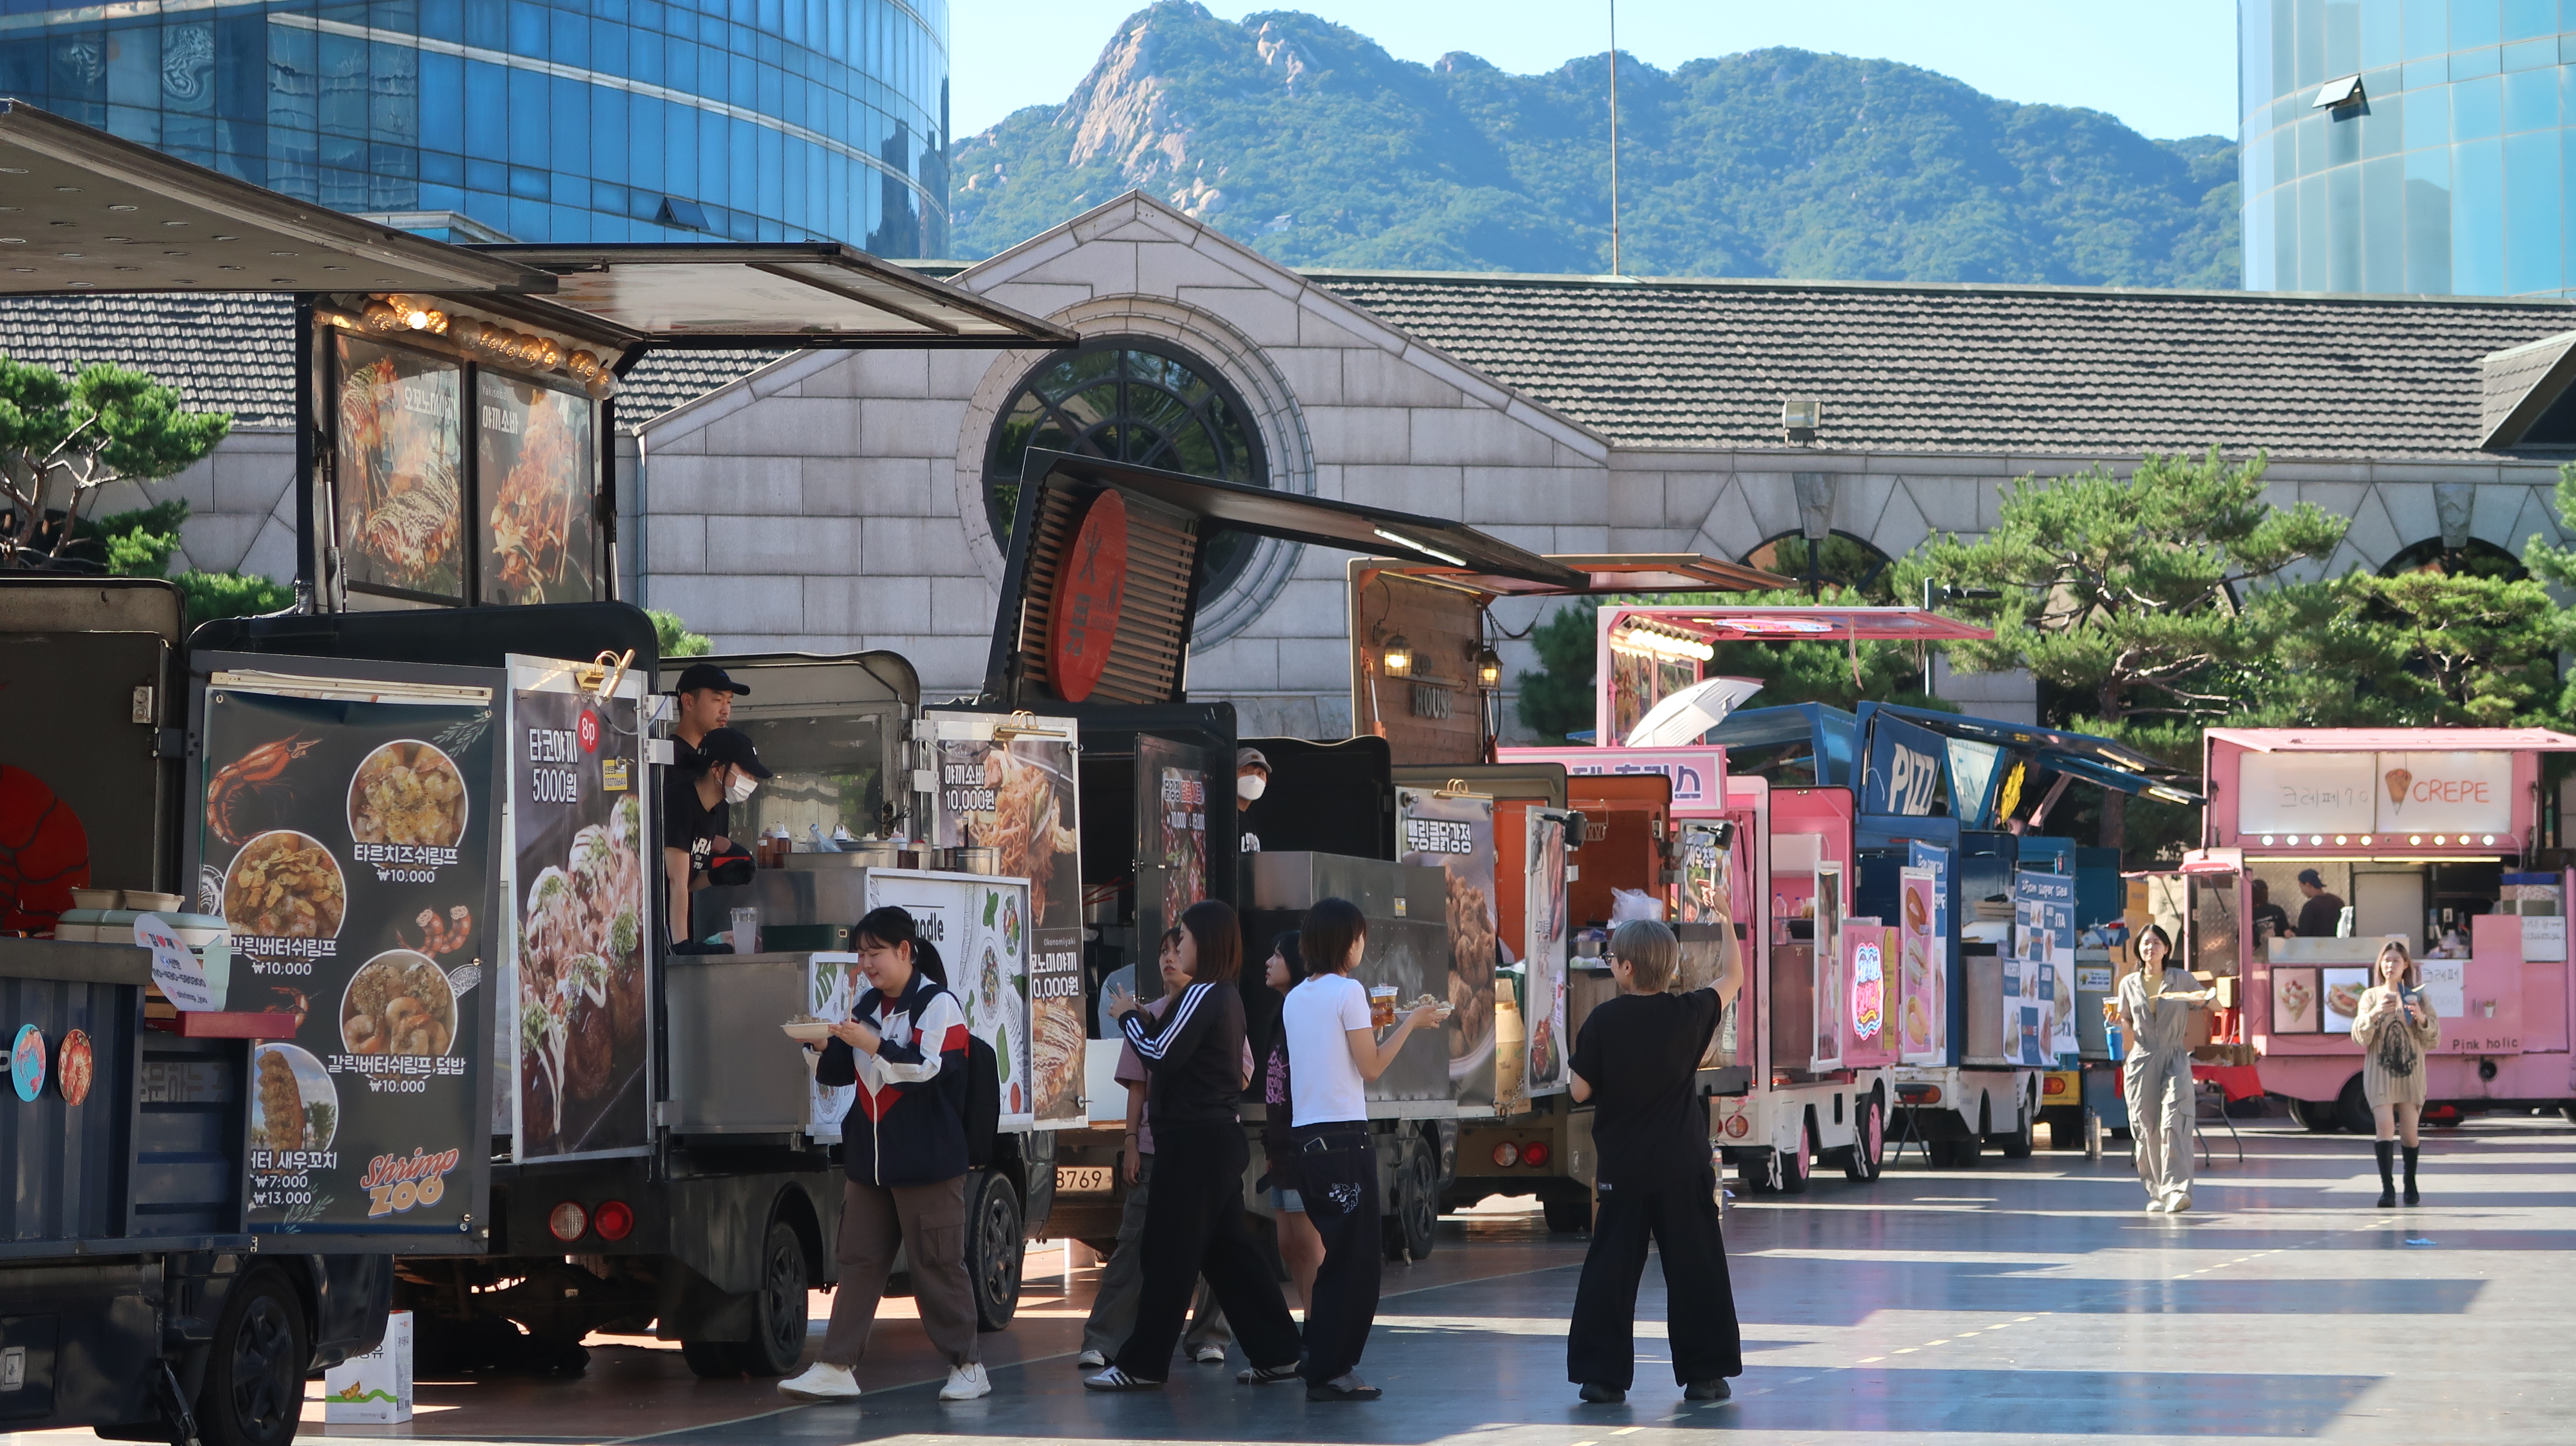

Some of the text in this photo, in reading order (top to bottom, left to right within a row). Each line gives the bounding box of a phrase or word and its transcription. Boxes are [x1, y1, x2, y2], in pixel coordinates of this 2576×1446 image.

[482, 384, 507, 400] Yakisoba
[483, 405, 518, 435] 야끼소바
[1416, 685, 1455, 719] HOUSE
[582, 716, 595, 746] 8p
[529, 728, 578, 764] 타코야끼
[533, 769, 577, 803] 5000원
[945, 764, 984, 785] 야끼소바
[1888, 743, 1940, 815] PIZZ
[946, 790, 995, 814] 10,000원
[2413, 780, 2489, 803] CREPE
[1407, 819, 1471, 853] 뿌링클닭강정
[354, 844, 458, 866] 타르치즈쉬림프
[230, 936, 336, 957] 갈릭버터쉬림프
[1044, 937, 1076, 947] Okonomiyaki
[1033, 975, 1079, 1001] 0,000원
[2453, 1037, 2518, 1050] Pink holic
[328, 1055, 466, 1075] 갈릭버터쉬림프 덮밥
[277, 1150, 337, 1170] 새우꼬치
[361, 1147, 459, 1189] Shrimp
[253, 1191, 311, 1205] ₩13,000
